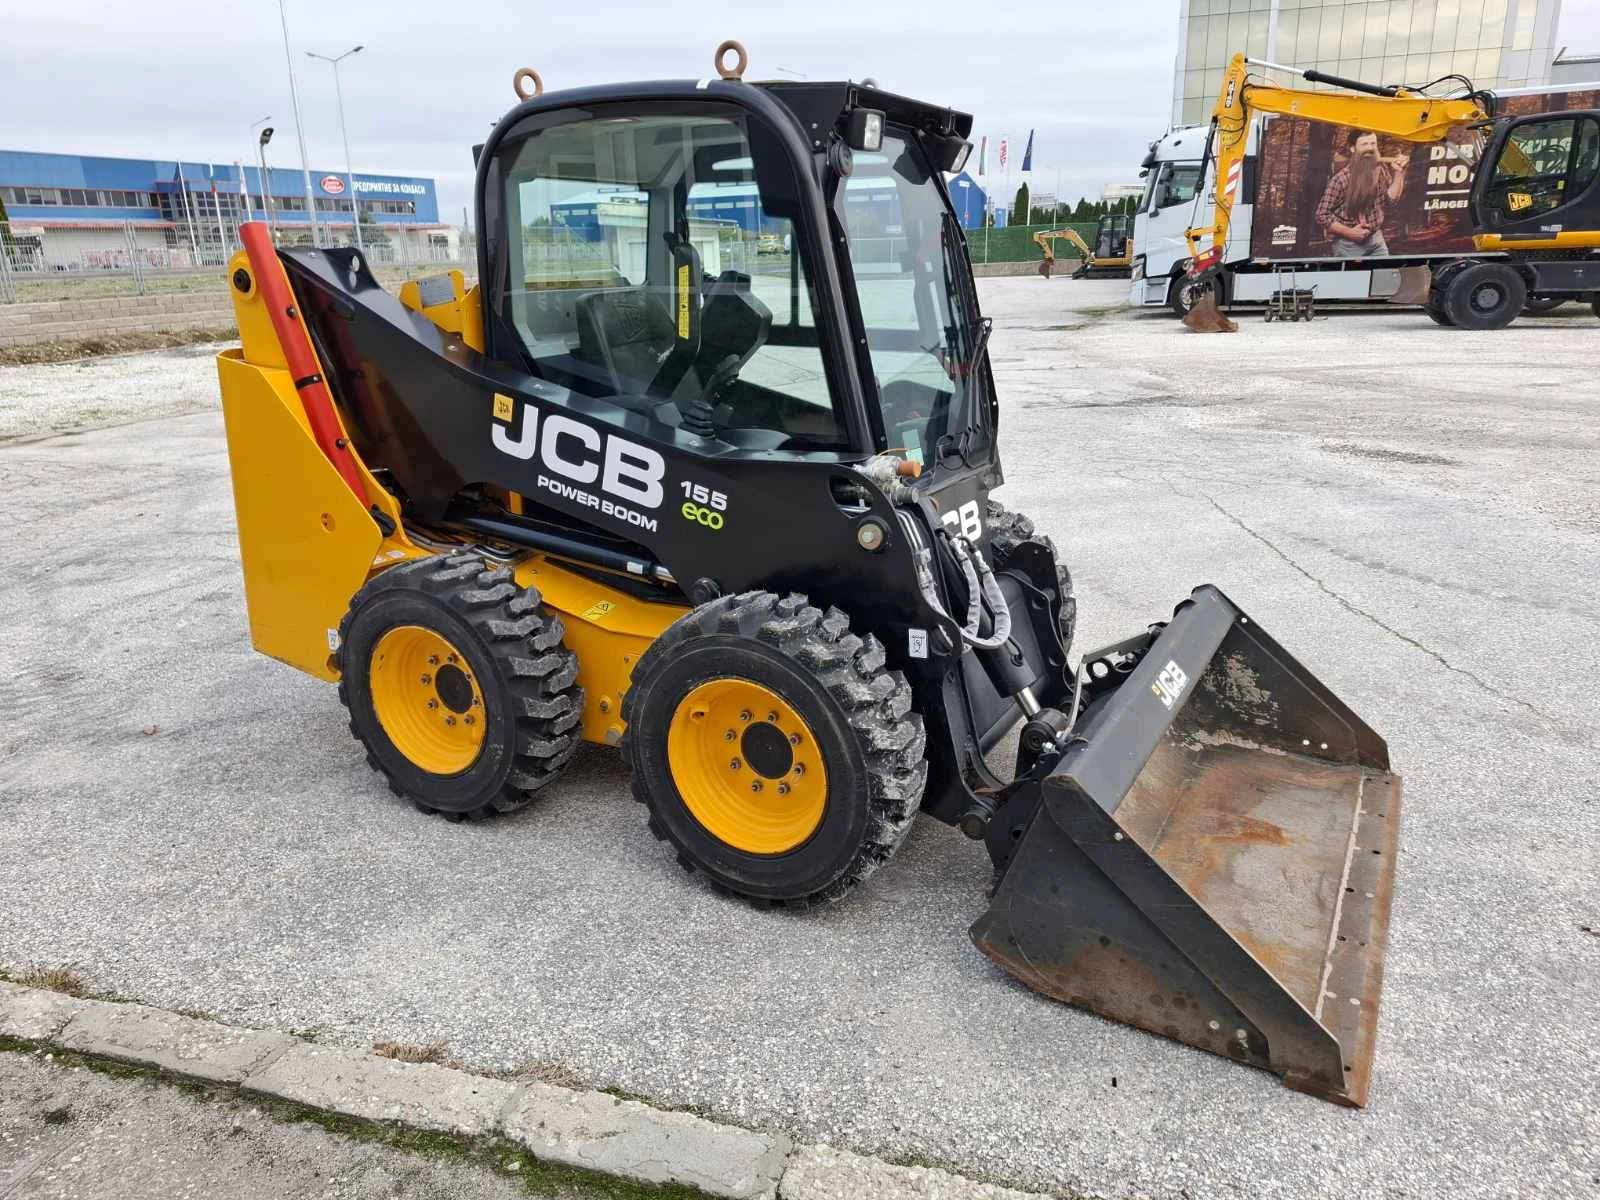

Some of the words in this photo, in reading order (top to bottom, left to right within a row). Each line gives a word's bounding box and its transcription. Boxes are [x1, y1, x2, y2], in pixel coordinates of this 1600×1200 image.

[393, 183, 400, 193] ЗА
[1427, 165, 1474, 185] HO
[1511, 194, 1531, 208] JCB
[492, 403, 666, 509] JCB
[537, 475, 600, 510] POWER
[601, 502, 657, 532] BOOM
[681, 481, 728, 511] 155
[682, 502, 724, 530] eco
[1155, 660, 1187, 706] JCB
